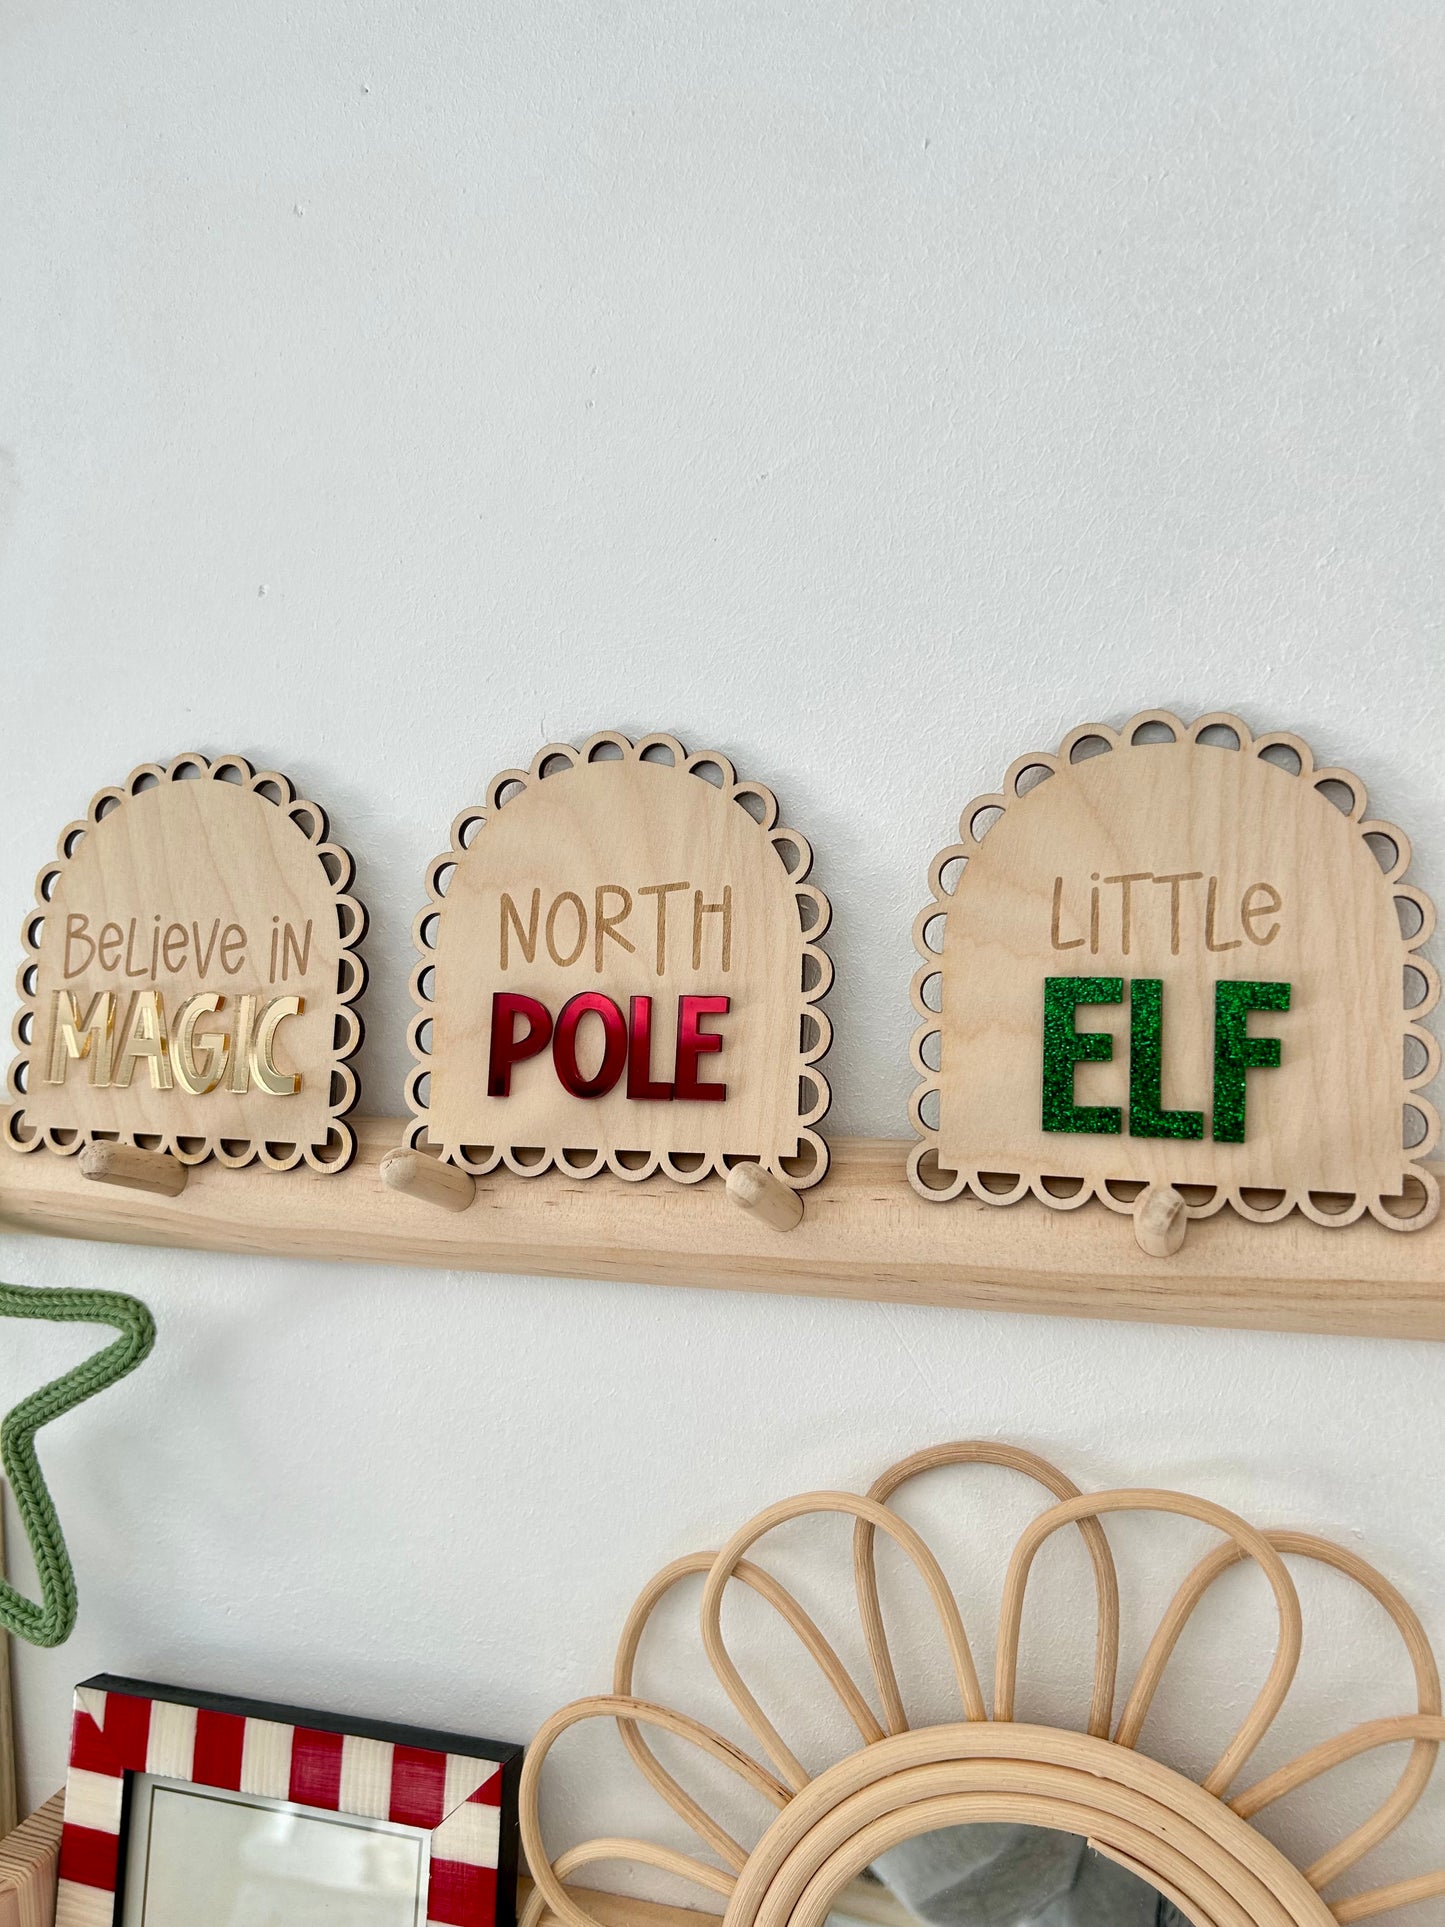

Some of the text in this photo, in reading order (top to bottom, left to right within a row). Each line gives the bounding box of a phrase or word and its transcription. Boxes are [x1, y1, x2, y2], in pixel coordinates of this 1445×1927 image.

[500, 881, 732, 976] NORTH
[43, 989, 305, 1096] MAGIC
[487, 990, 731, 1101] POLE
[1041, 976, 1291, 1143] ELF
